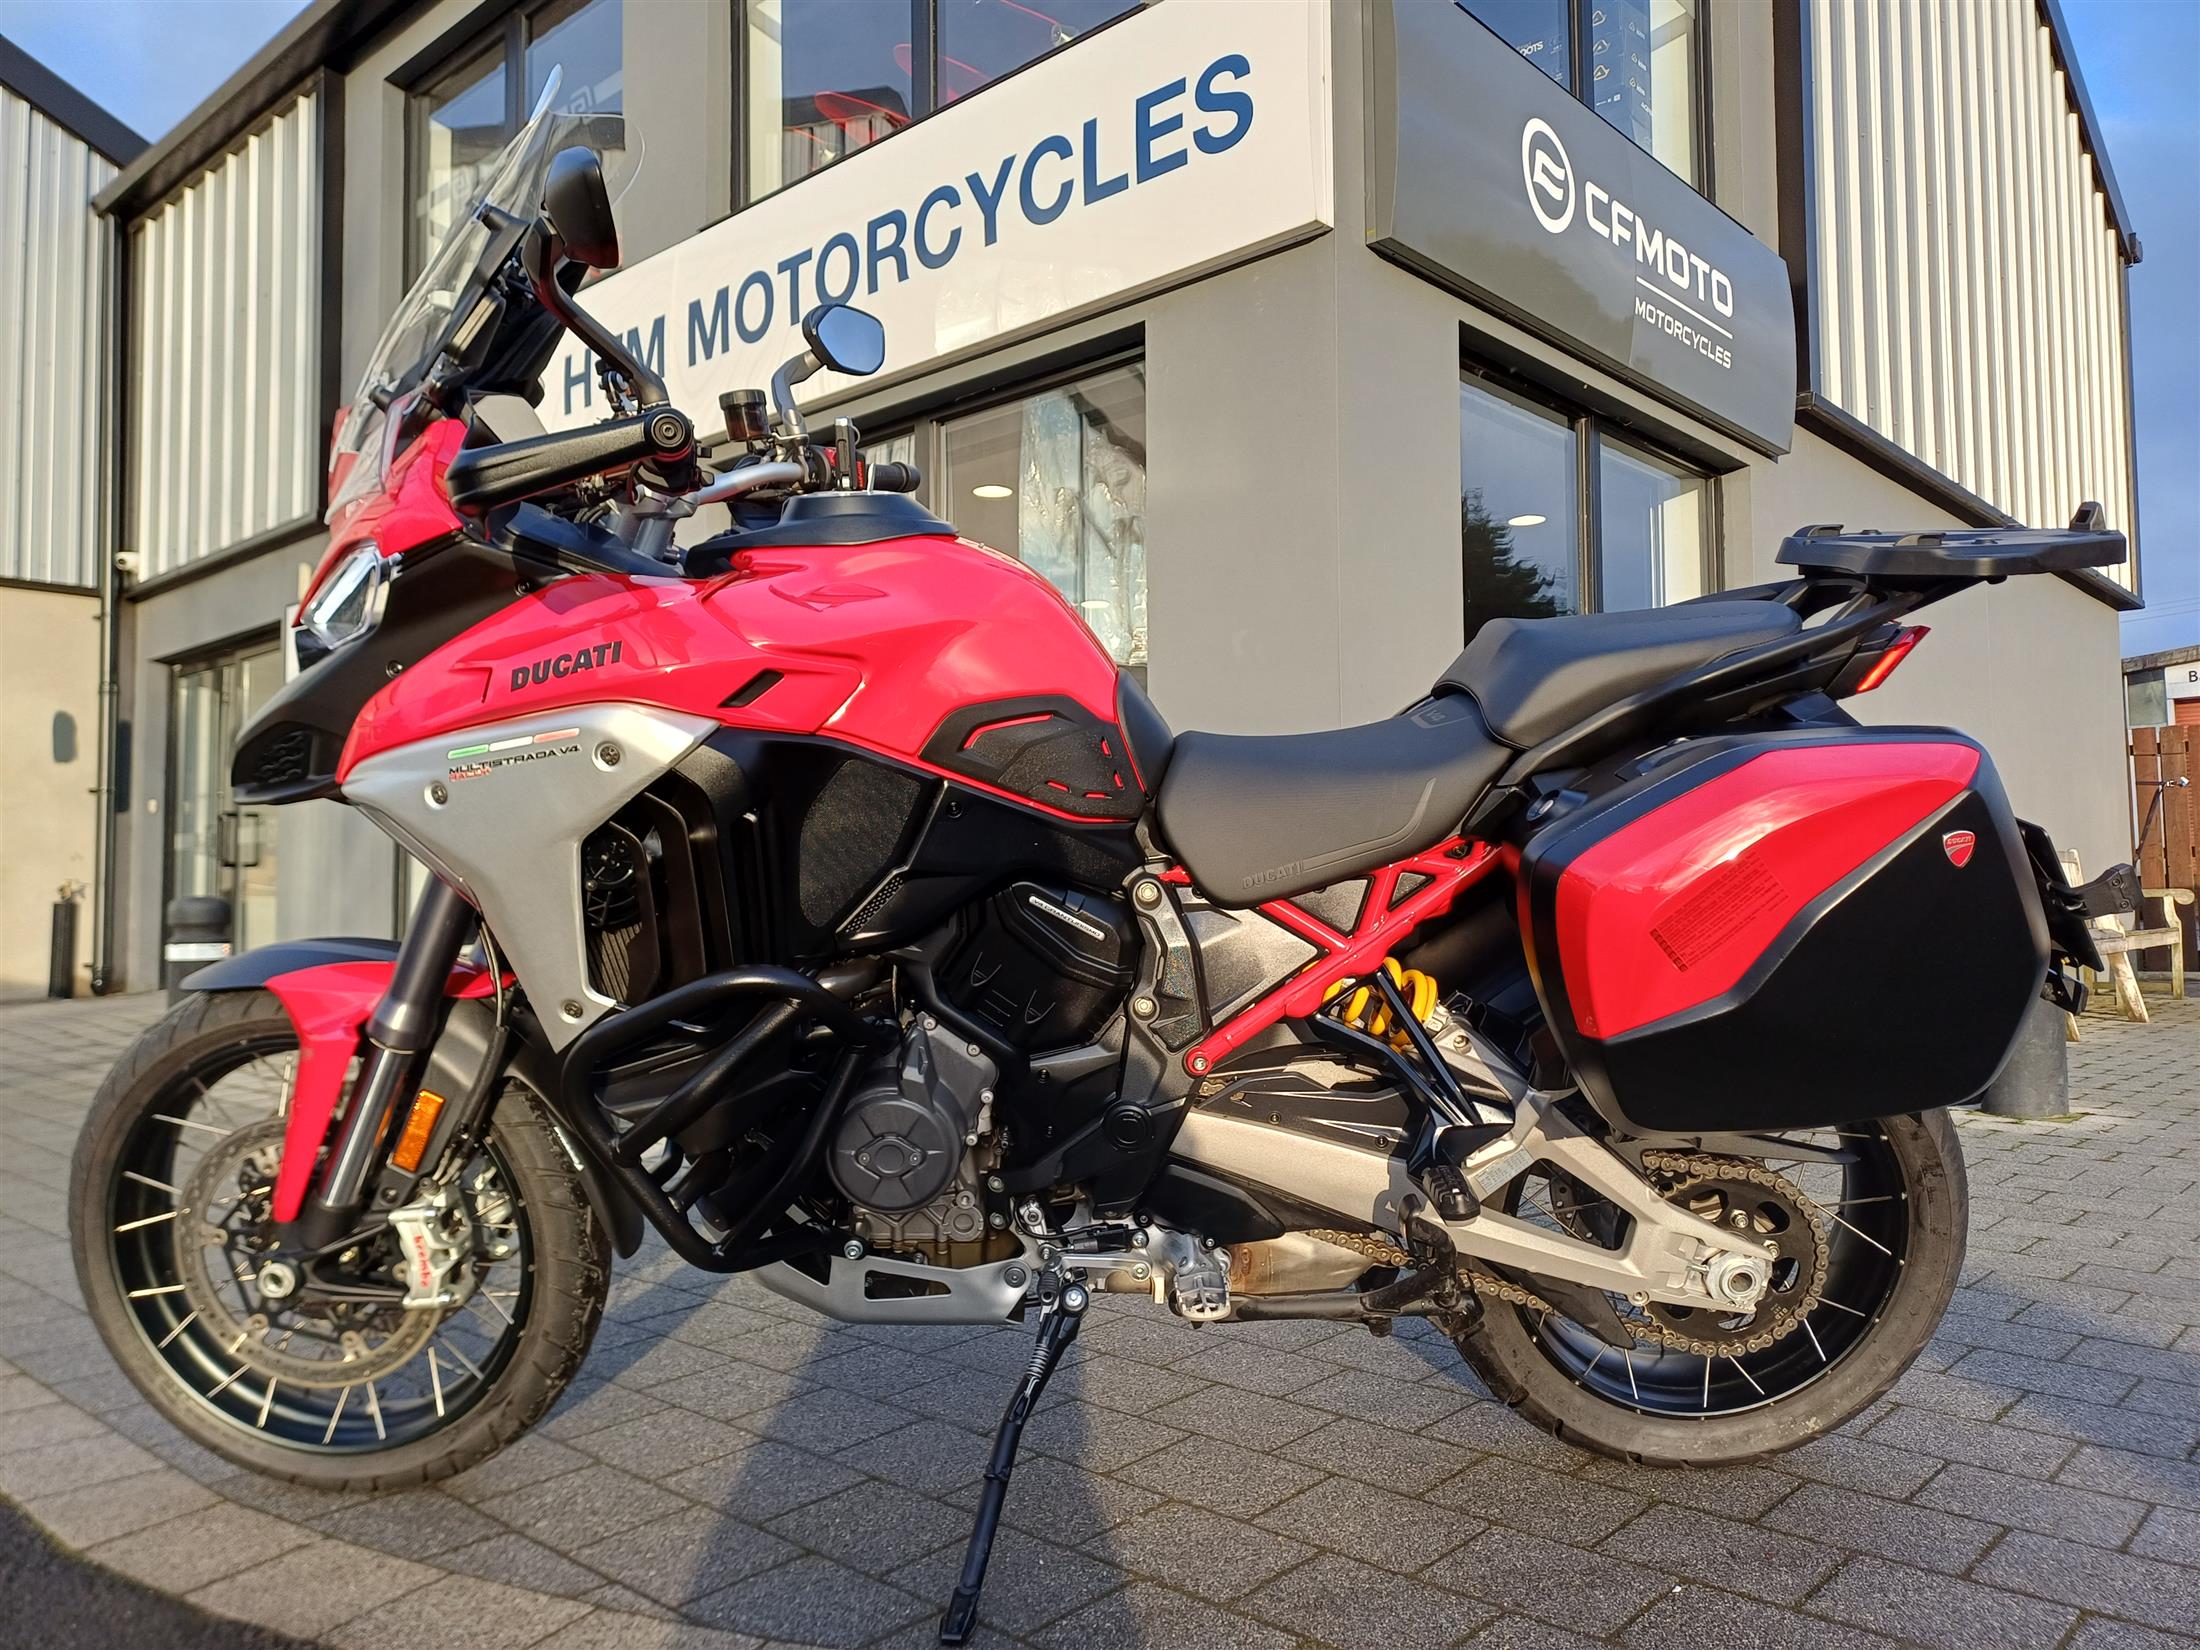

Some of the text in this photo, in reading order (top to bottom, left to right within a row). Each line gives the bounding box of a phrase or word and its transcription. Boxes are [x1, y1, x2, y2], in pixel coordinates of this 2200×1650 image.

[1519, 41, 1544, 56] OOTS
[564, 54, 1253, 415] HM MOTORCYCLES
[1585, 181, 1733, 318] CFMOTO
[1635, 296, 1732, 369] MOTORCYCLES
[510, 640, 623, 692] DUCATI
[2188, 670, 2200, 683] B
[448, 744, 581, 775] MULTISTRADA V4
[1242, 860, 1303, 889] DUCATI
[414, 1234, 431, 1289] brembo
